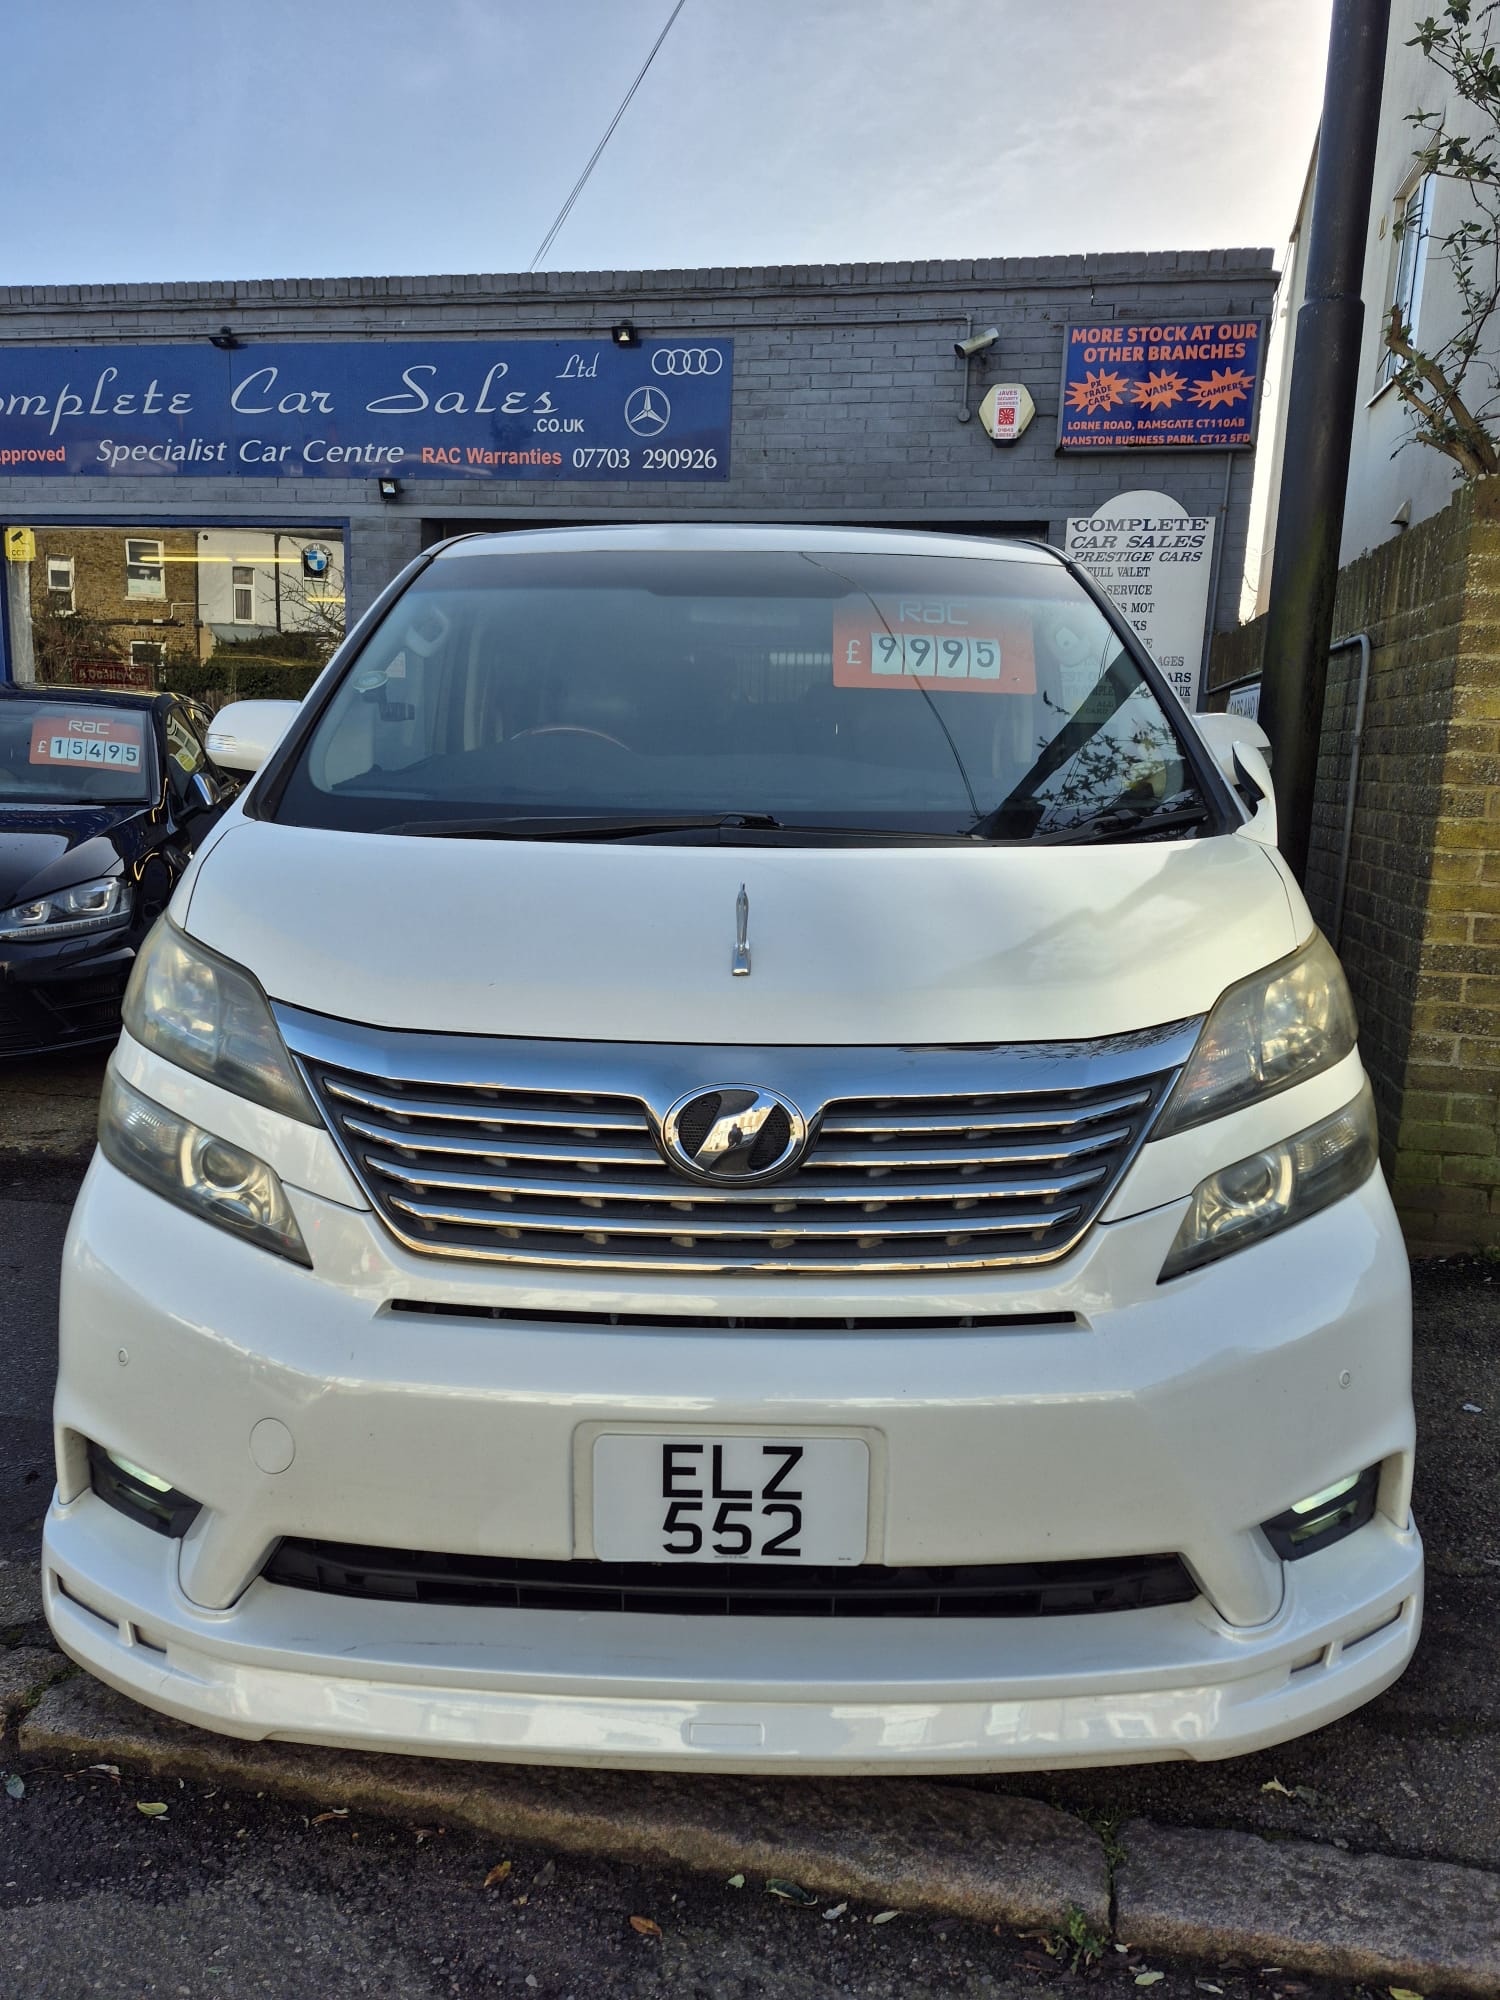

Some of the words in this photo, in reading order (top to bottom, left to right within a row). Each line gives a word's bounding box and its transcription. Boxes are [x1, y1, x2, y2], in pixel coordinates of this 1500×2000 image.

[1071, 328, 1123, 345] MORE
[1127, 326, 1187, 343] STOCK
[1191, 325, 1215, 341] AT
[1217, 323, 1258, 340] OUR
[1083, 346, 1144, 363] OTHER
[1148, 343, 1246, 361] BRANCHES
[555, 352, 600, 379] Ltd
[230, 366, 335, 414] Car
[366, 362, 559, 414] Sales
[1083, 384, 1112, 399] TRADE
[1145, 381, 1174, 397] VANS
[1200, 380, 1244, 399] CAMPERS
[1088, 394, 1111, 405] CARS
[532, 418, 585, 434] .CO.UK
[1067, 421, 1101, 431] LORNE
[1103, 420, 1135, 431] ROAD,
[1137, 419, 1194, 430] RAMSGATE
[1062, 436, 1113, 445] MANSTON
[1115, 435, 1164, 444] BUSINESS
[1200, 434, 1227, 443] CT12
[0, 446, 66, 465] pproved
[96, 438, 227, 468] Specialist
[239, 440, 292, 463] Car
[302, 440, 404, 464] Centre
[421, 448, 461, 463] RAC
[466, 448, 562, 465] Warranties
[572, 448, 630, 469] 07703
[642, 449, 717, 470] 290926
[1075, 518, 1206, 532] COMPLETE
[1070, 535, 1118, 549] CAR
[1126, 534, 1206, 549] SALES
[1074, 551, 1155, 562] PRESTIGE
[1159, 551, 1203, 562] CARS
[1117, 566, 1150, 577] VALET
[1106, 584, 1153, 596] SERVICE
[1130, 602, 1155, 613] MOT
[662, 1444, 804, 1501] ELZ
[662, 1501, 803, 1557] 552
